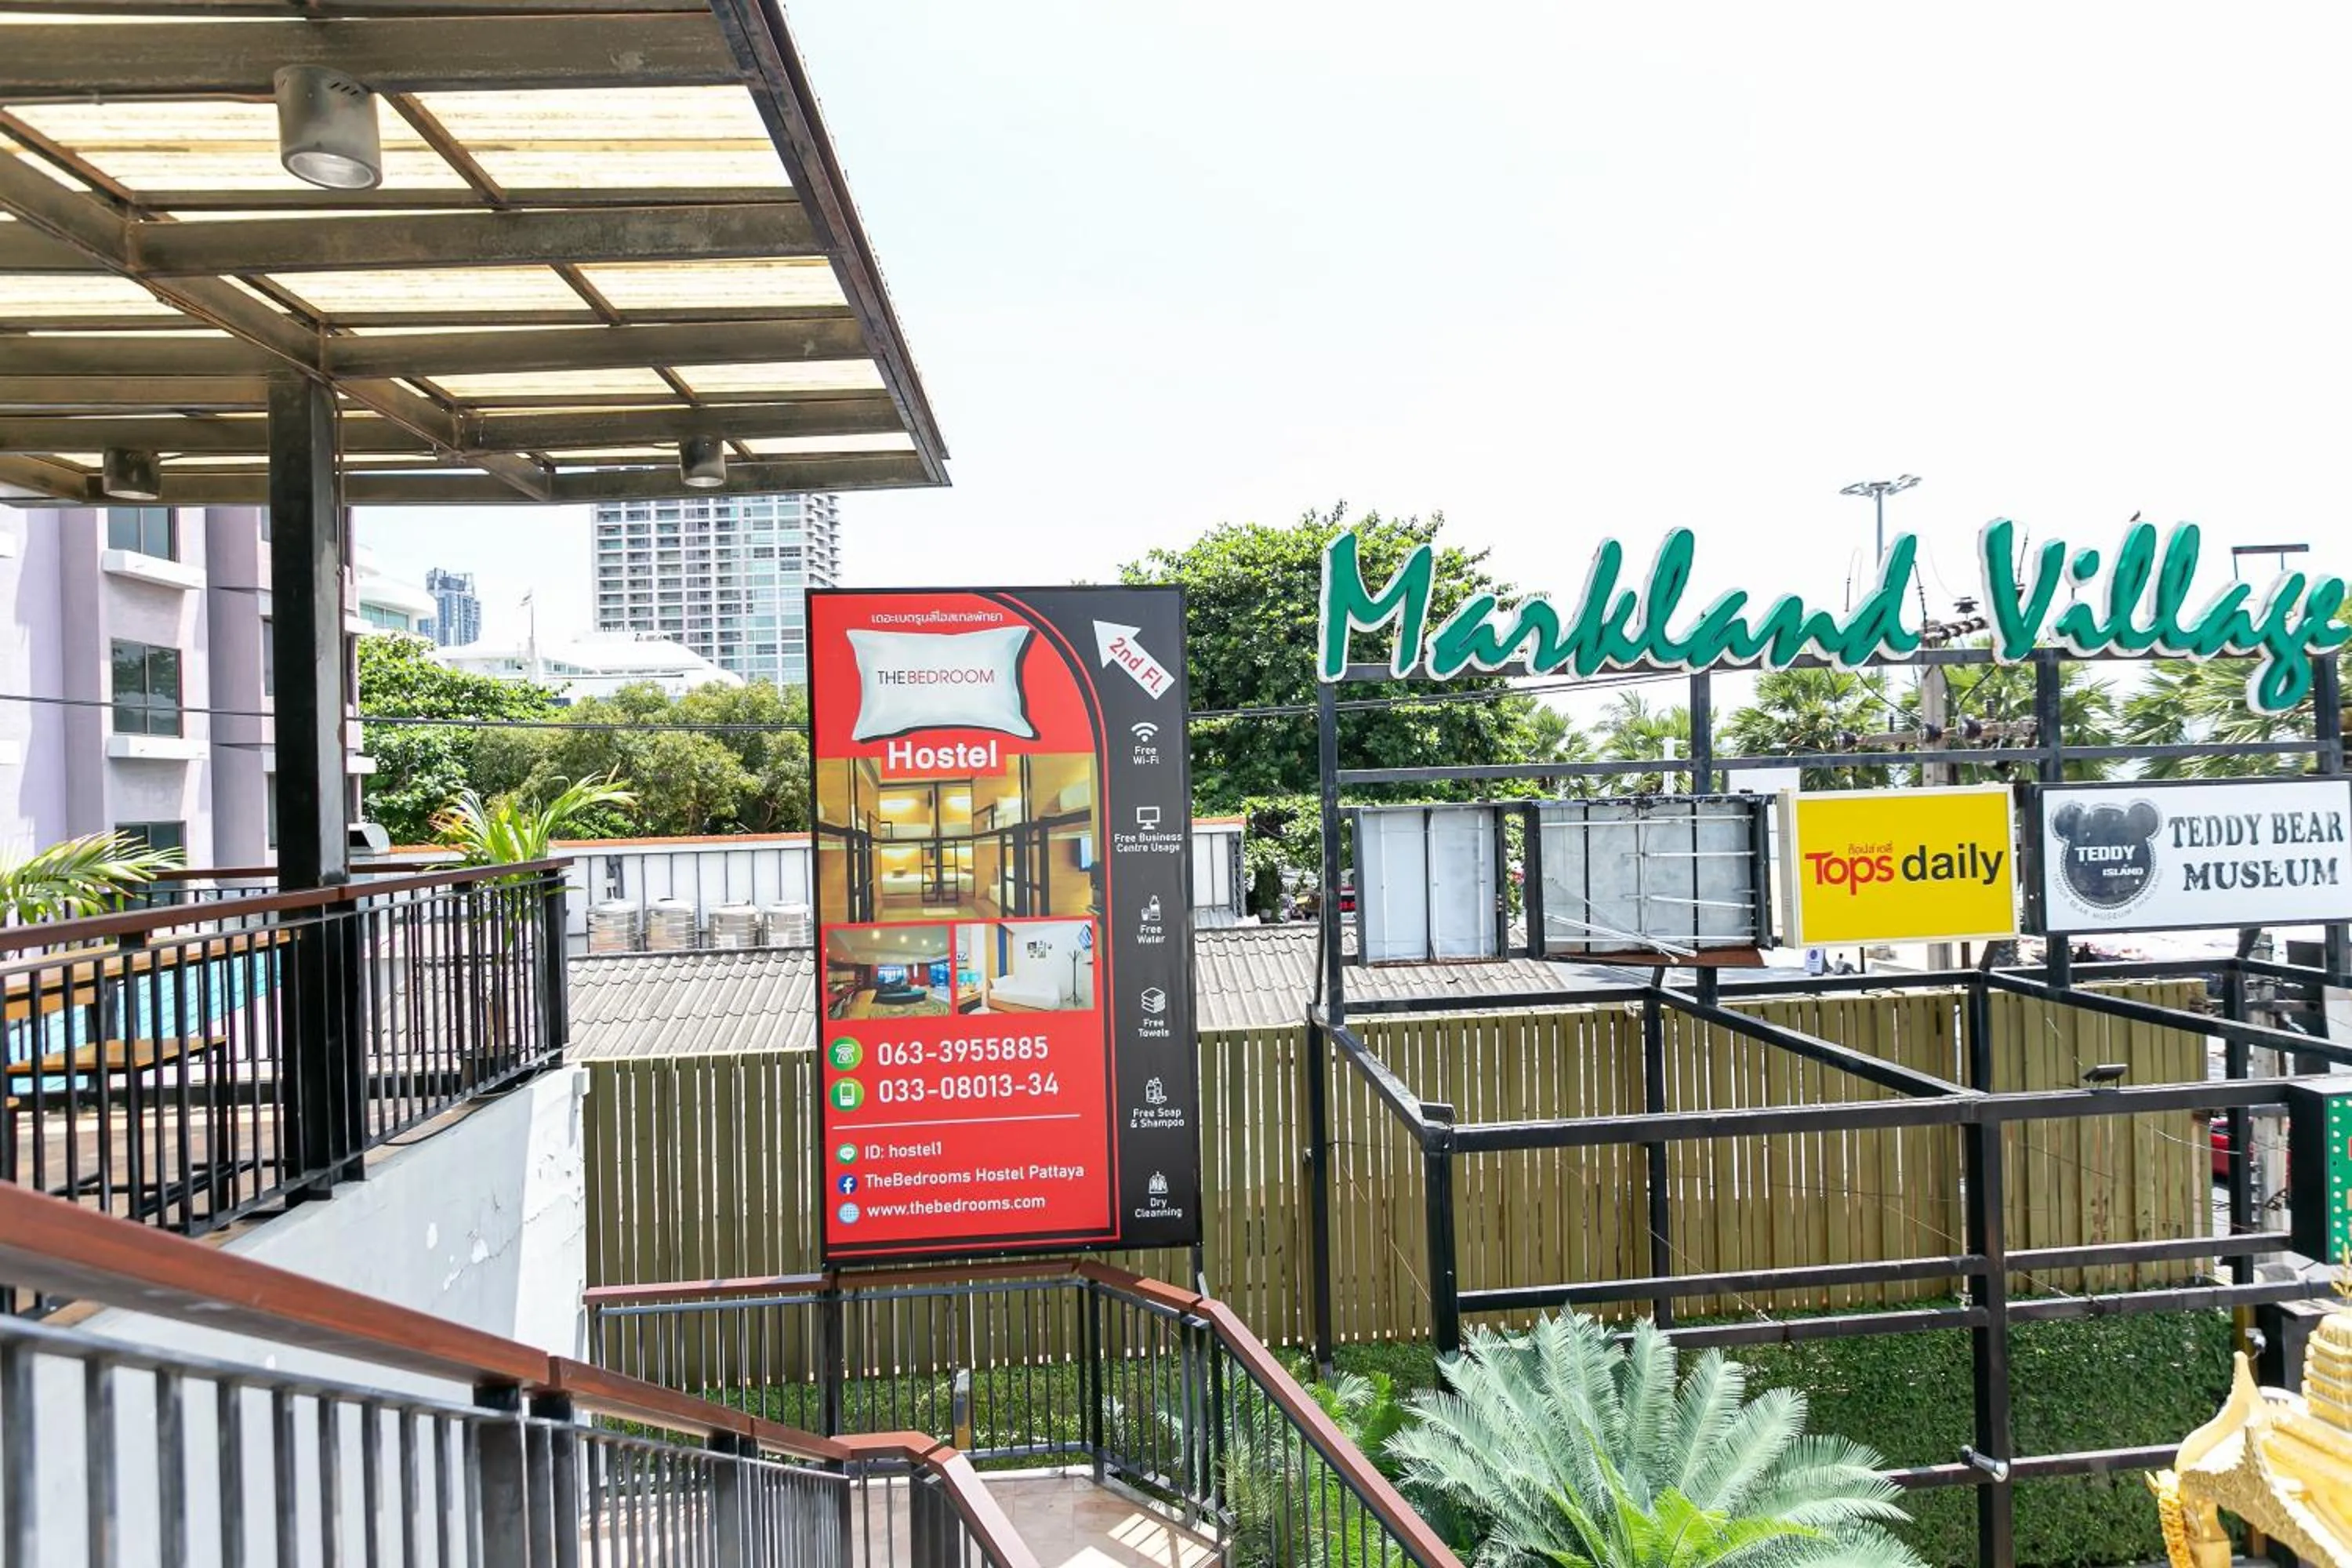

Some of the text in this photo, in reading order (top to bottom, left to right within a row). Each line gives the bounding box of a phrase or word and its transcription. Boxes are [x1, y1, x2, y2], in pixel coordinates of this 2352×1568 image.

[1318, 517, 2352, 716] Markland Village
[1109, 637, 1145, 671] 2nd
[888, 739, 996, 769] Hostel
[1133, 756, 1160, 764] Wi-Fi
[1114, 832, 1183, 843] Free Business
[2169, 811, 2343, 848] TEDDY BEAR
[1150, 842, 1180, 853] Usage
[2074, 845, 2136, 862] TEDDY
[1805, 843, 2005, 895] Tops daily
[2102, 867, 2144, 877] ISLAND
[2183, 857, 2339, 891] MUSEUM
[1140, 924, 1163, 934] Free
[1137, 934, 1165, 944] Water
[1143, 1018, 1164, 1027] Free
[1138, 1028, 1170, 1037] Towels
[877, 1036, 1048, 1065] 063-3955885
[879, 1072, 1058, 1102] 033-08013-34
[1133, 1108, 1181, 1119] Free Soap
[1130, 1118, 1185, 1129] & Shampoo
[865, 1141, 942, 1160] ID: hostel1
[866, 1164, 1084, 1189] TheBedrooms Hostel Pattaya
[867, 1196, 1045, 1217] www.thebedrooms.com
[1149, 1197, 1167, 1208] Dry
